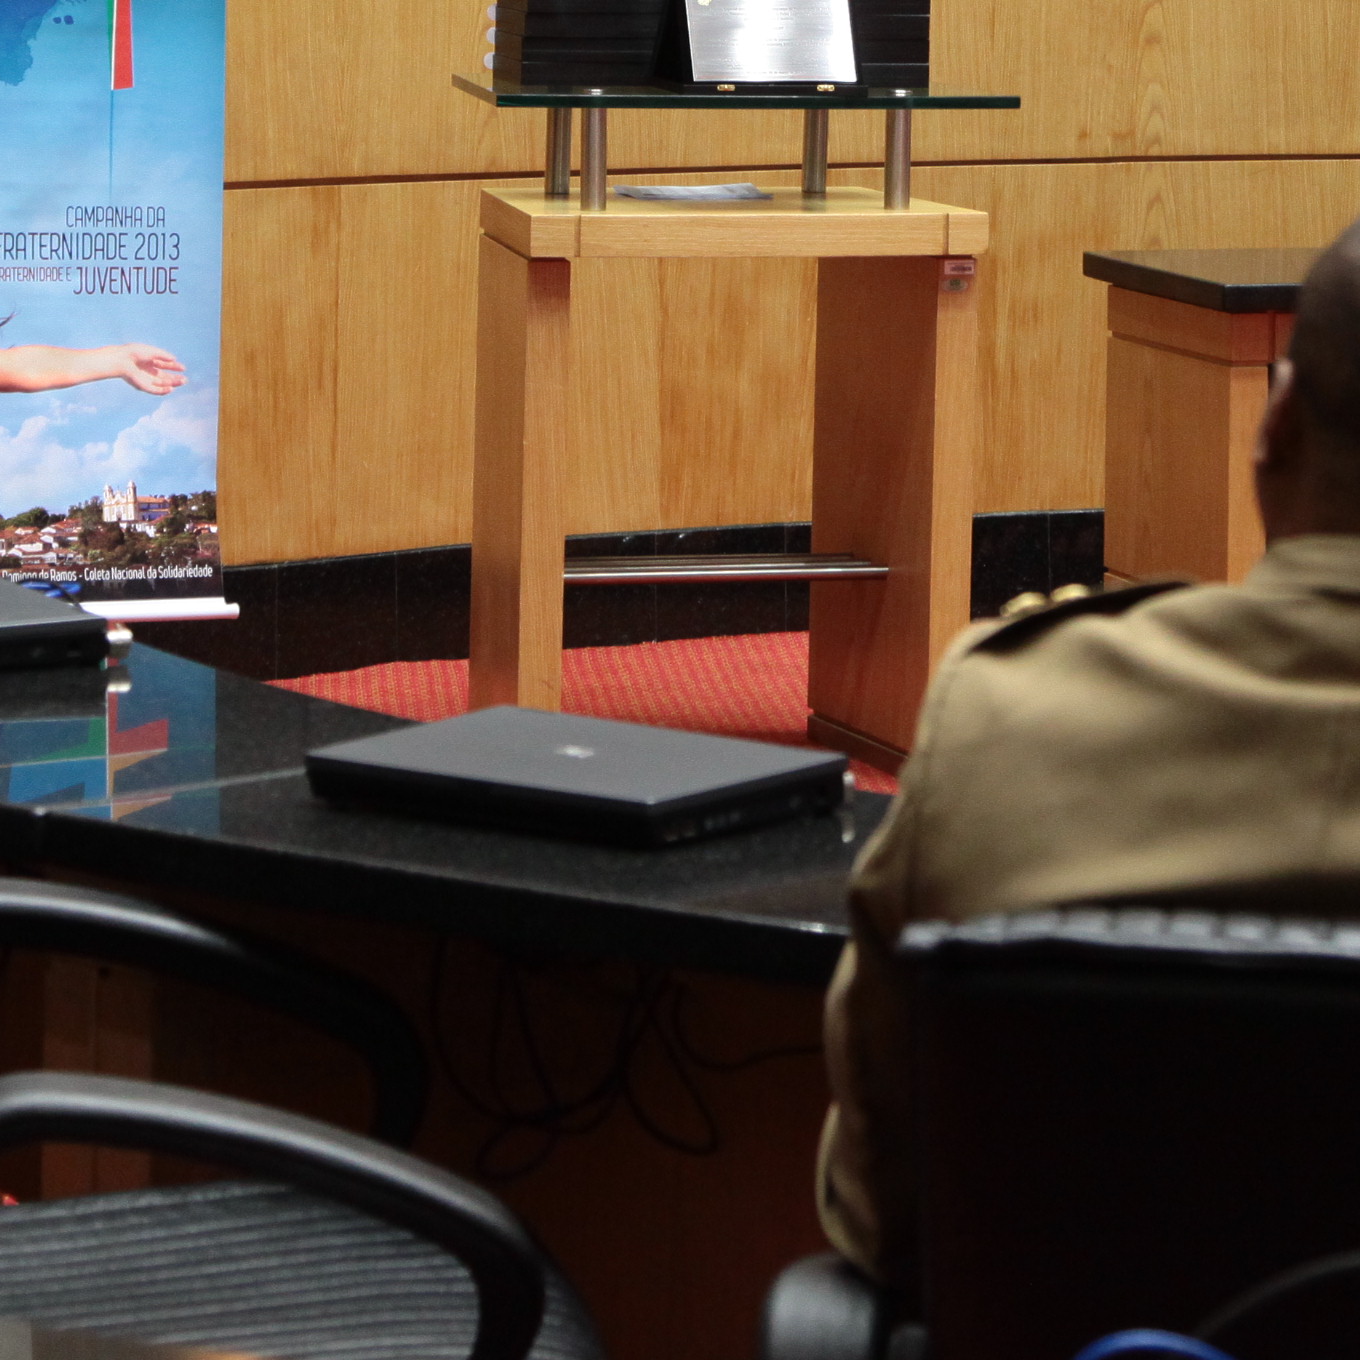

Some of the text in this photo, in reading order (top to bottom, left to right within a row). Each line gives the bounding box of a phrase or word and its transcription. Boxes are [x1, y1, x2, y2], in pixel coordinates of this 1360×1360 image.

[65, 205, 166, 228] CAMPANHA DA
[134, 232, 181, 261] 2013
[65, 266, 72, 282] E
[73, 266, 180, 295] JUVENTUDE
[50, 568, 77, 582] Ramos
[84, 566, 110, 581] Coleta
[111, 566, 146, 580] Nacional
[147, 566, 157, 579] da
[158, 564, 213, 579] Solidariedade
